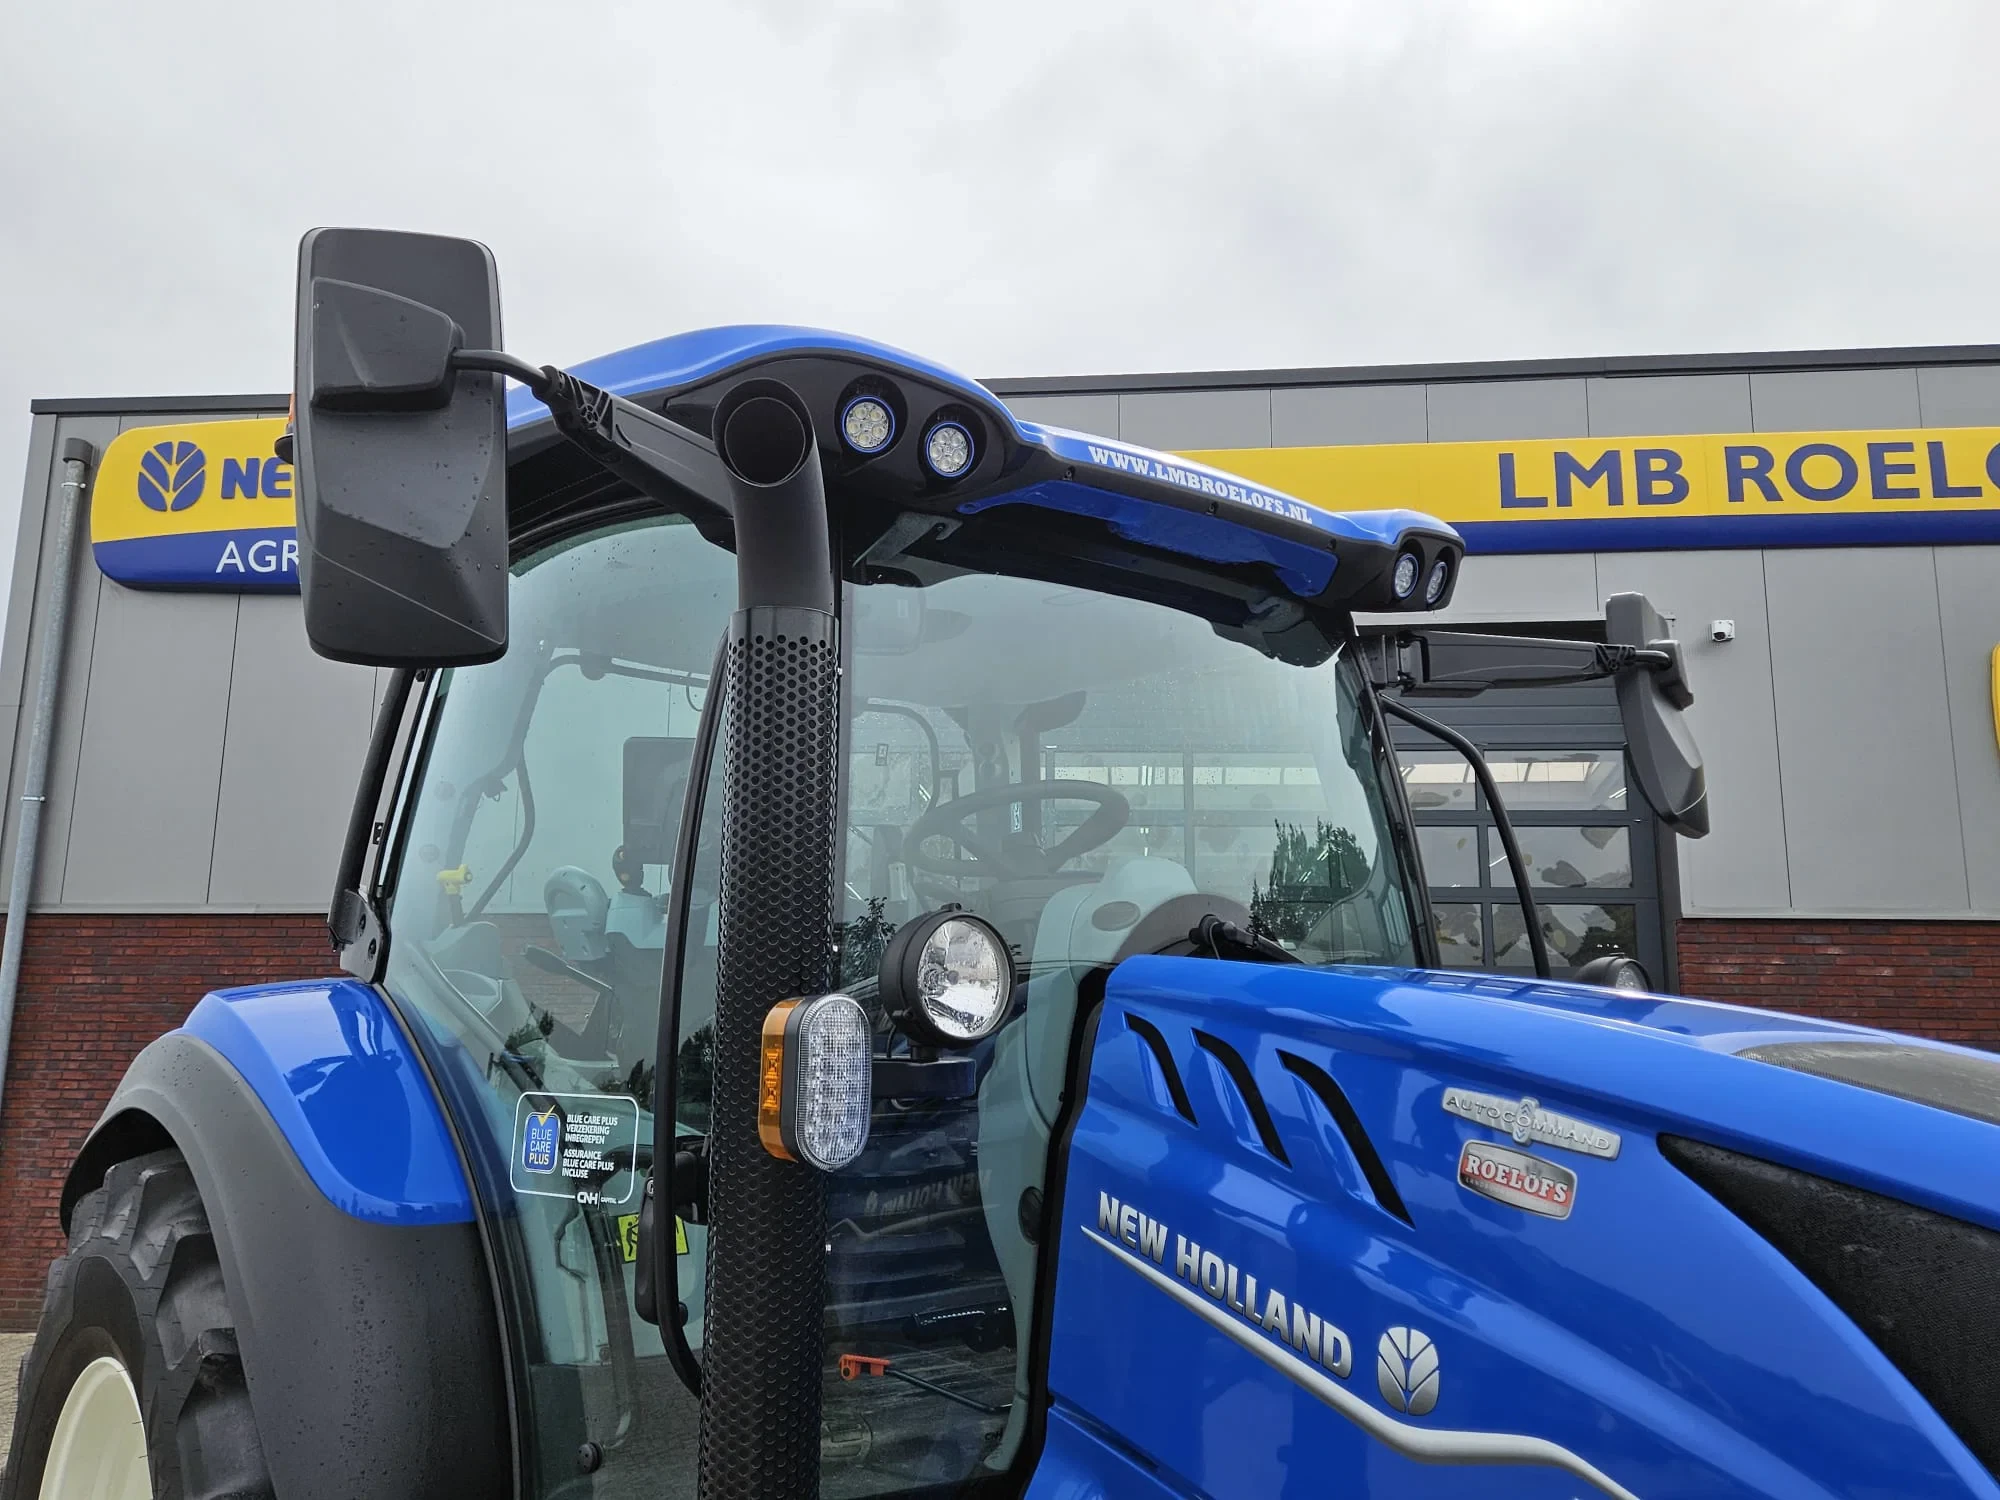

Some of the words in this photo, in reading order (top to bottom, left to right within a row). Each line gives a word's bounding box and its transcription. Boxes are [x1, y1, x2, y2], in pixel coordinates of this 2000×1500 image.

[1498, 448, 1690, 509] LMB
[1724, 441, 2000, 503] ROEL
[1088, 445, 1313, 525] WWW.LMBROELOFS.NL
[566, 1114, 583, 1123] BLUE
[583, 1115, 601, 1125] CARE
[601, 1116, 619, 1126] PLUS
[1445, 1095, 1612, 1151] AUTOCOMMAND
[531, 1128, 553, 1141] BLUE
[565, 1124, 610, 1135] VERZEKERING
[564, 1133, 605, 1145] INBEGREPEN
[530, 1140, 552, 1153] CARE
[528, 1152, 550, 1165] PLUS
[563, 1149, 602, 1160] ASSURANCE
[562, 1158, 580, 1168] BLUE
[579, 1159, 597, 1170] CARE
[597, 1161, 615, 1172] PLUS
[561, 1168, 589, 1179] INCLUSE
[576, 1191, 598, 1205] CNH
[1098, 1190, 1168, 1265] NEW
[1175, 1232, 1353, 1380] HOLLAND
